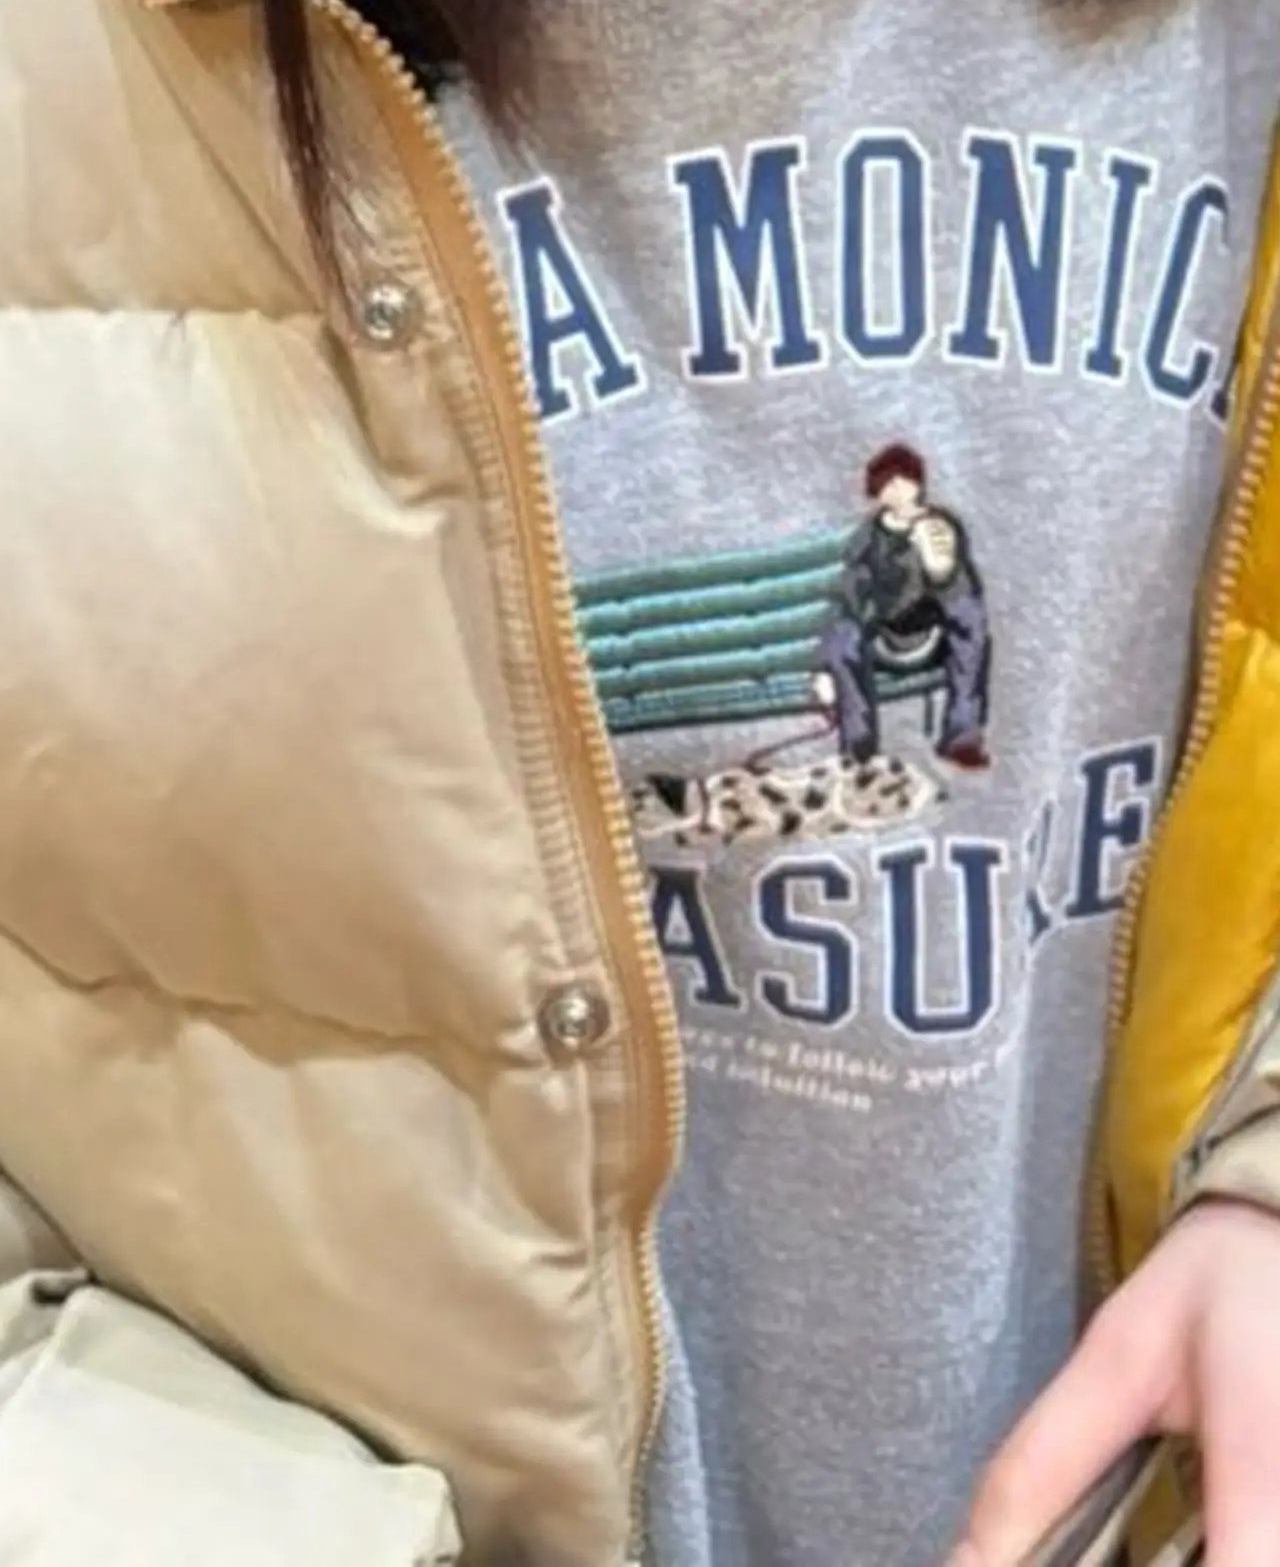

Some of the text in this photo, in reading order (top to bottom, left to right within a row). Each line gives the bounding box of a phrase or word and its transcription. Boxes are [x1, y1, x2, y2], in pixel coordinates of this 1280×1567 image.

[496, 127, 1236, 424] A MONIC
[644, 734, 1162, 1040] ASUE
